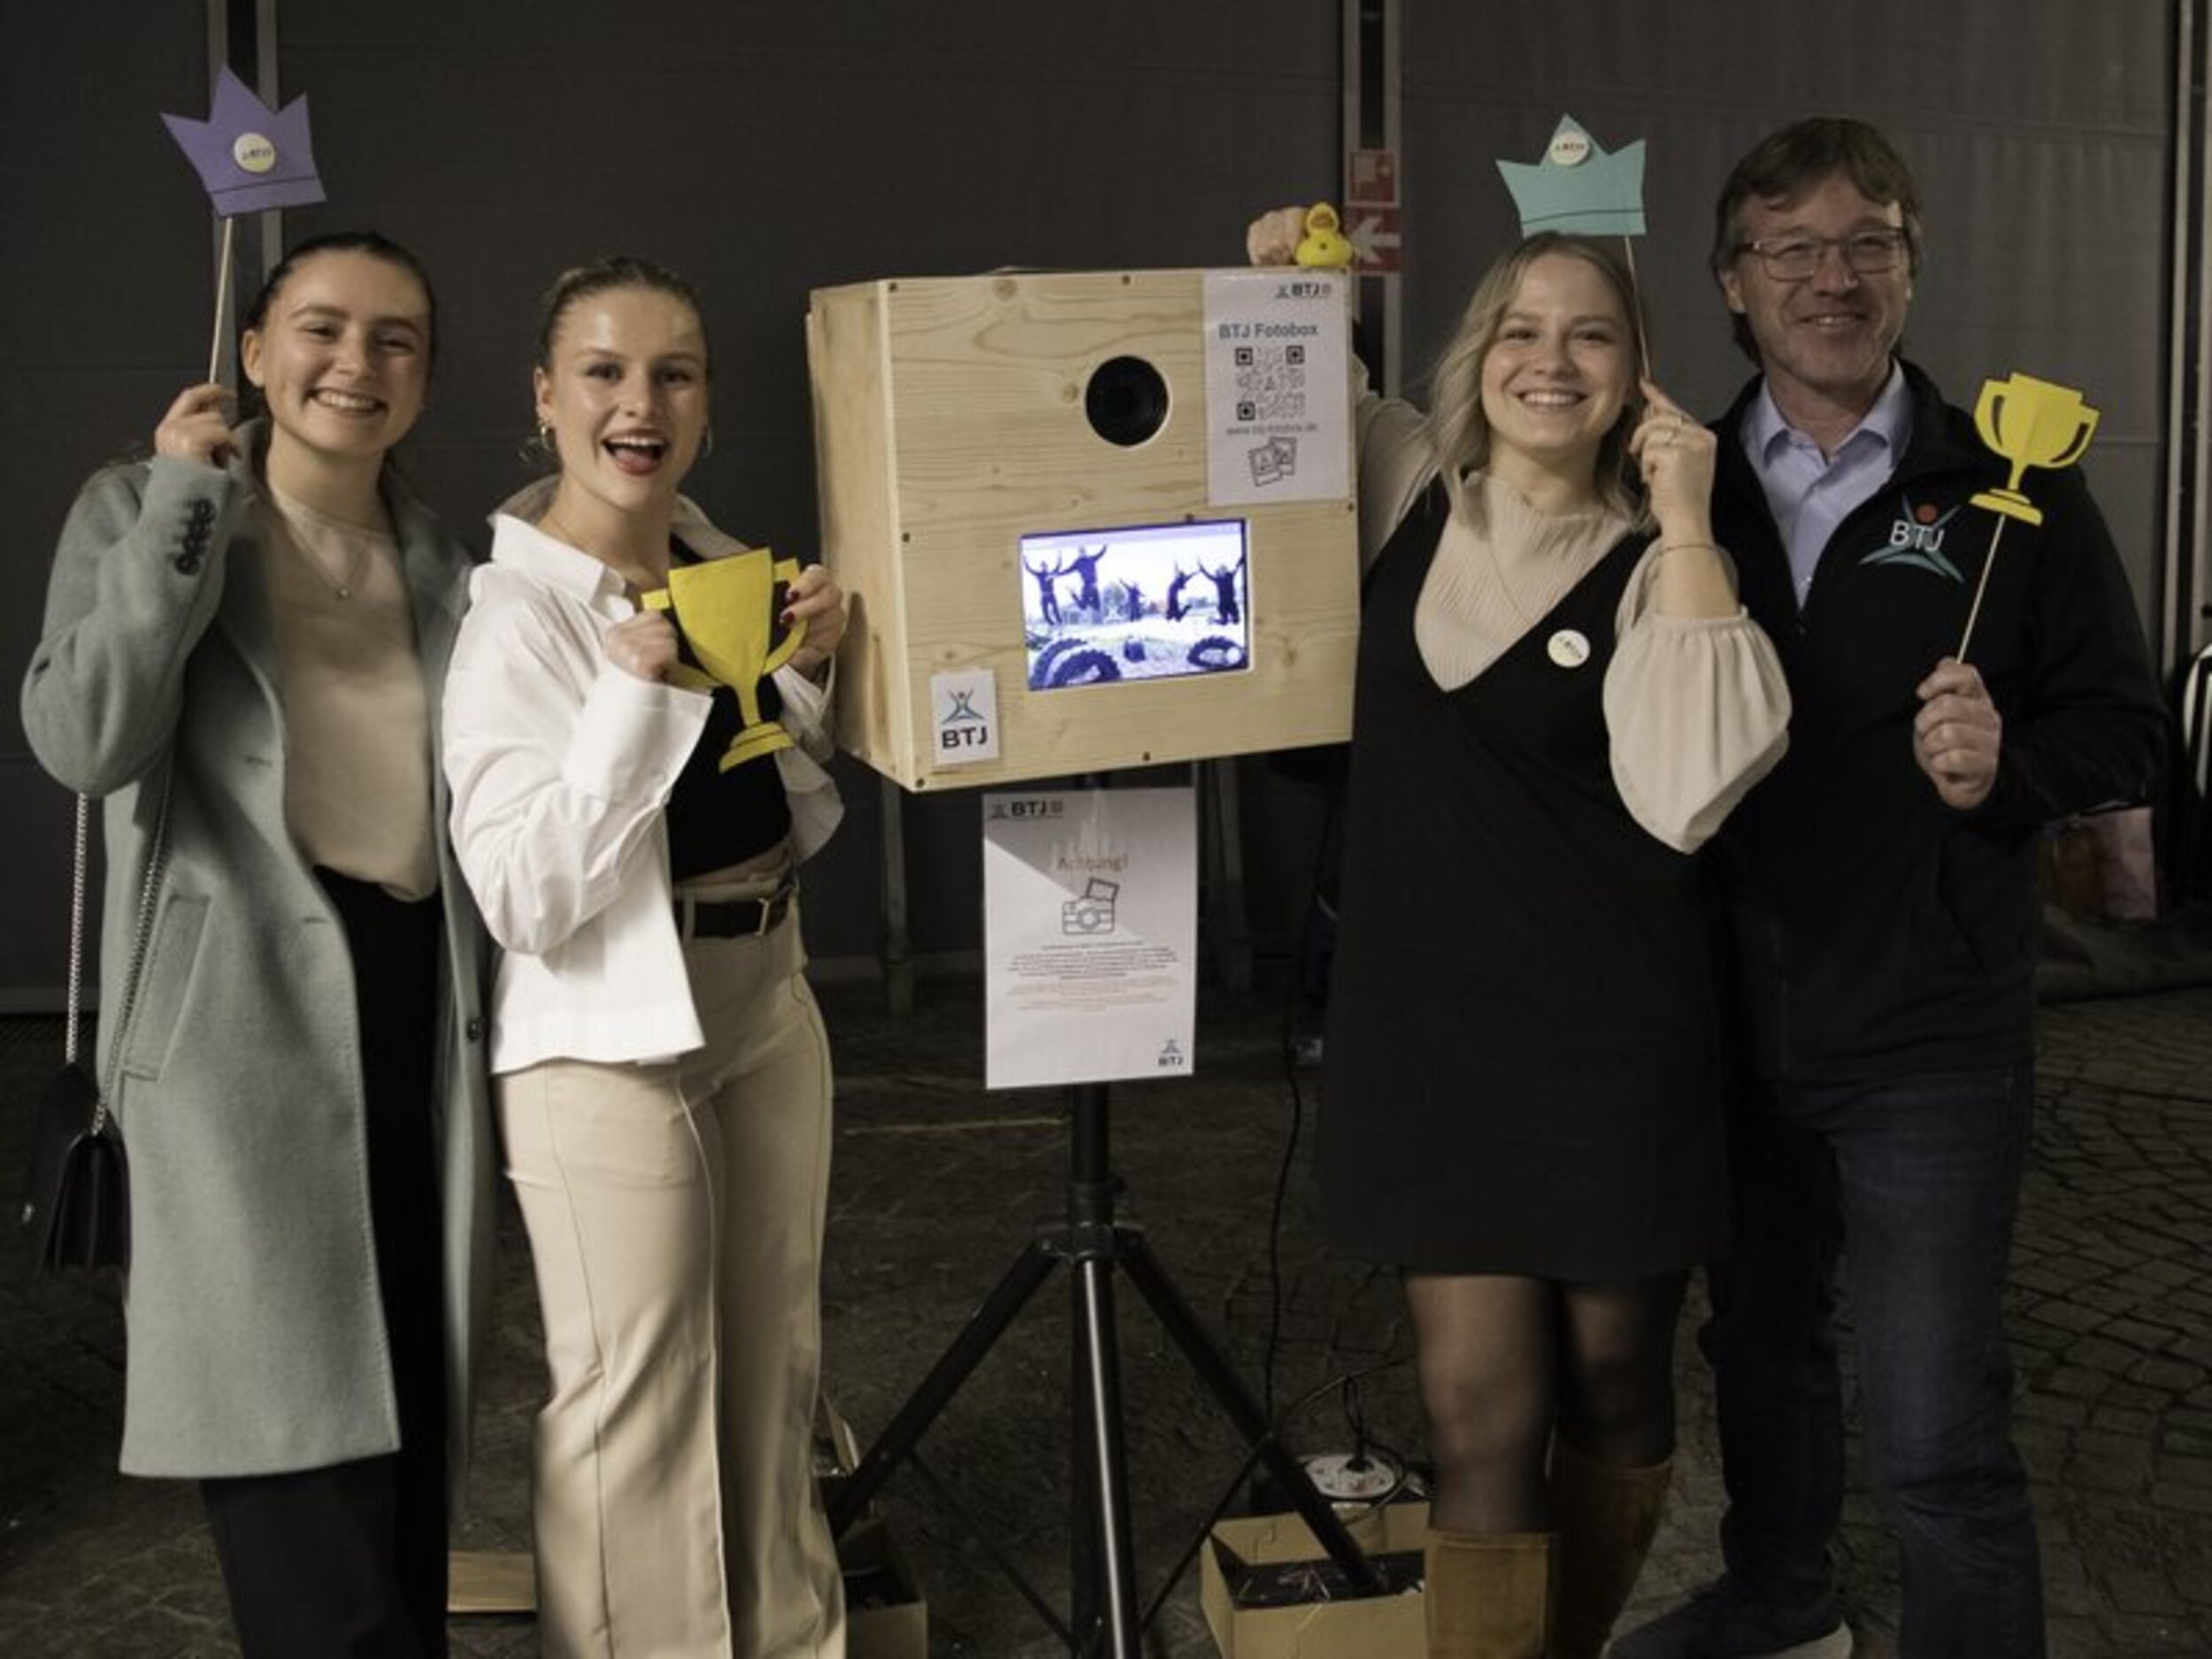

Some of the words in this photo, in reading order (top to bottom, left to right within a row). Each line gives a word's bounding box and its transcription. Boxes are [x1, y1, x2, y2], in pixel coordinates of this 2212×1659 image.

[1292, 282, 1319, 297] BTJ
[1219, 323, 1250, 339] BTJ
[1255, 321, 1318, 337] Fotobox
[1890, 519, 1945, 551] BTJ
[941, 726, 987, 749] BTJ
[1011, 801, 1046, 816] BTJ
